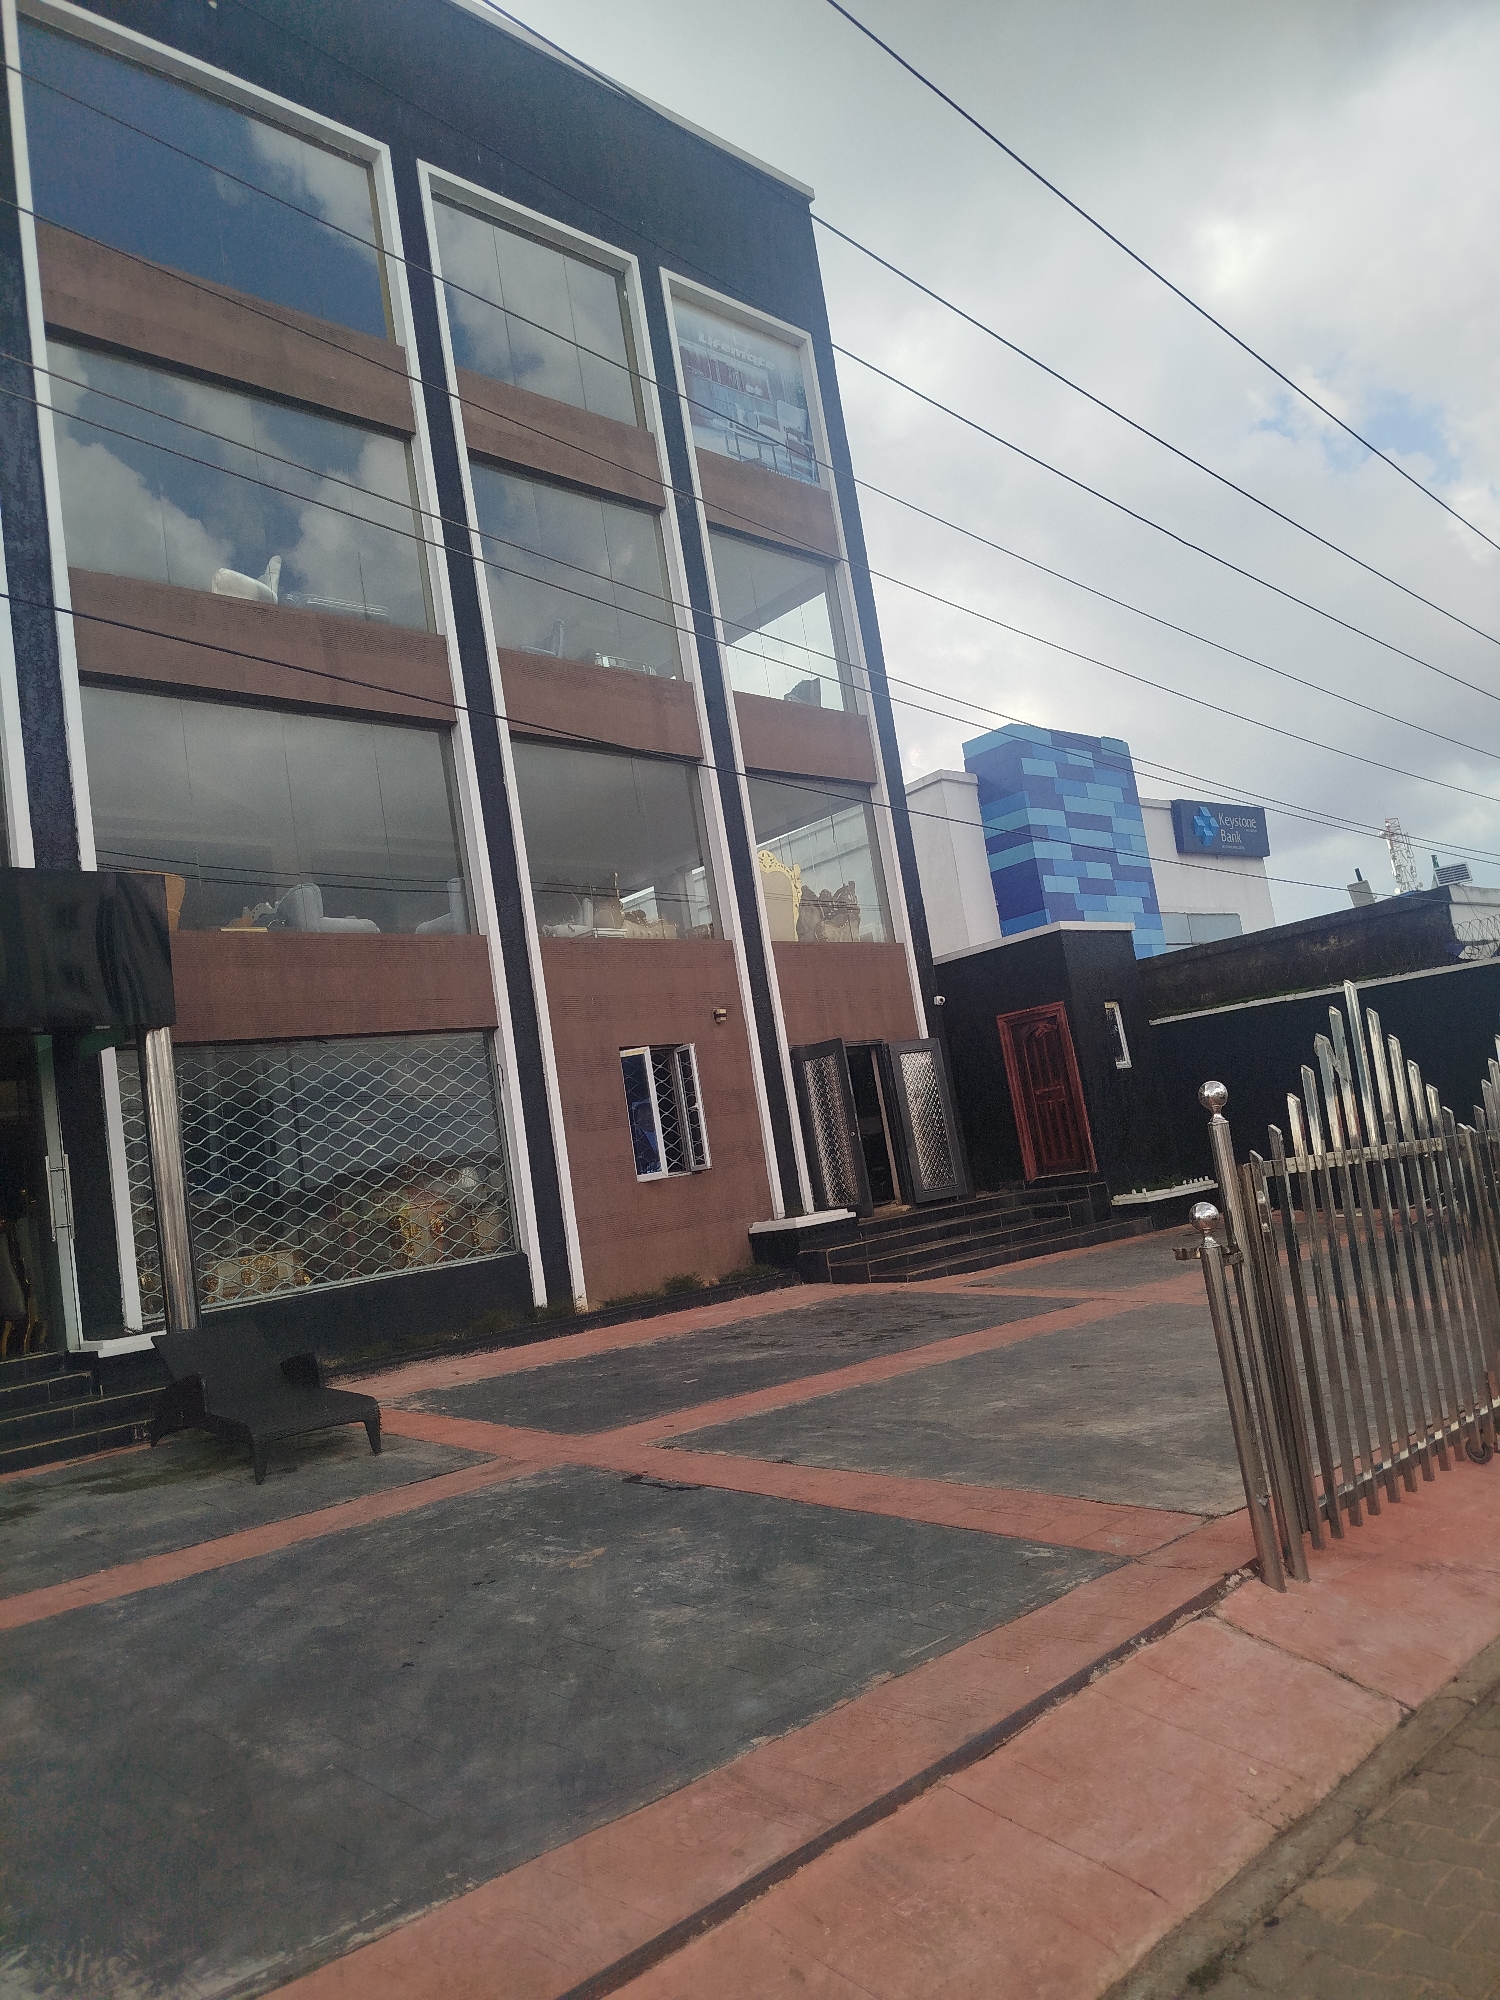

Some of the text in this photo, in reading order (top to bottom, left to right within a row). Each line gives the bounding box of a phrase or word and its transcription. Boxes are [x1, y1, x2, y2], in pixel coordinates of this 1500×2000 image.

[698, 332, 775, 370] Lifemate
[1218, 812, 1257, 830] Keystone
[1220, 828, 1243, 844] Bank
